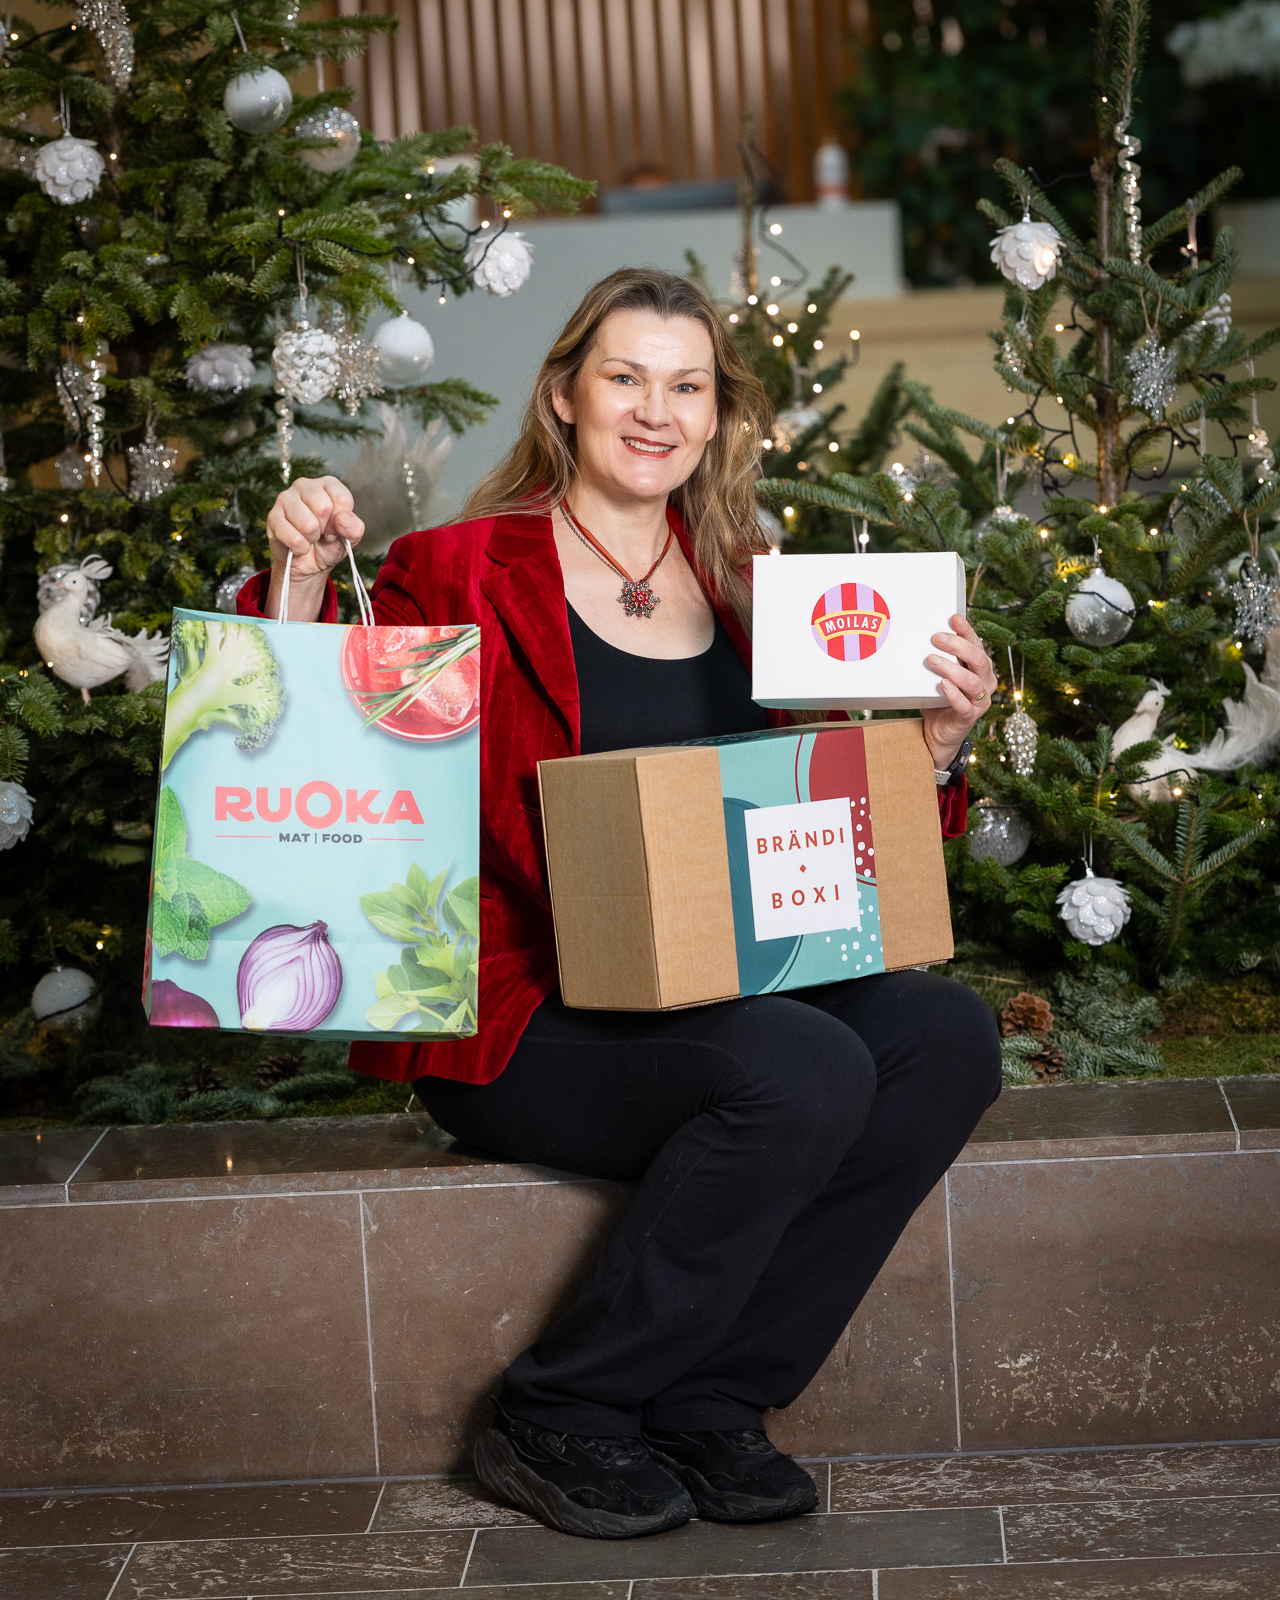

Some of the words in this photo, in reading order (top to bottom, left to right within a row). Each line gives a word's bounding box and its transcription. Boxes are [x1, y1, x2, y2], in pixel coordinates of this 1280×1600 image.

[825, 616, 879, 634] MOILAS
[215, 780, 425, 829] RUOKA
[279, 833, 311, 843] MAT
[322, 833, 363, 844] FOOD
[757, 827, 844, 856] BRÄNDI
[771, 884, 840, 911] BOXI
